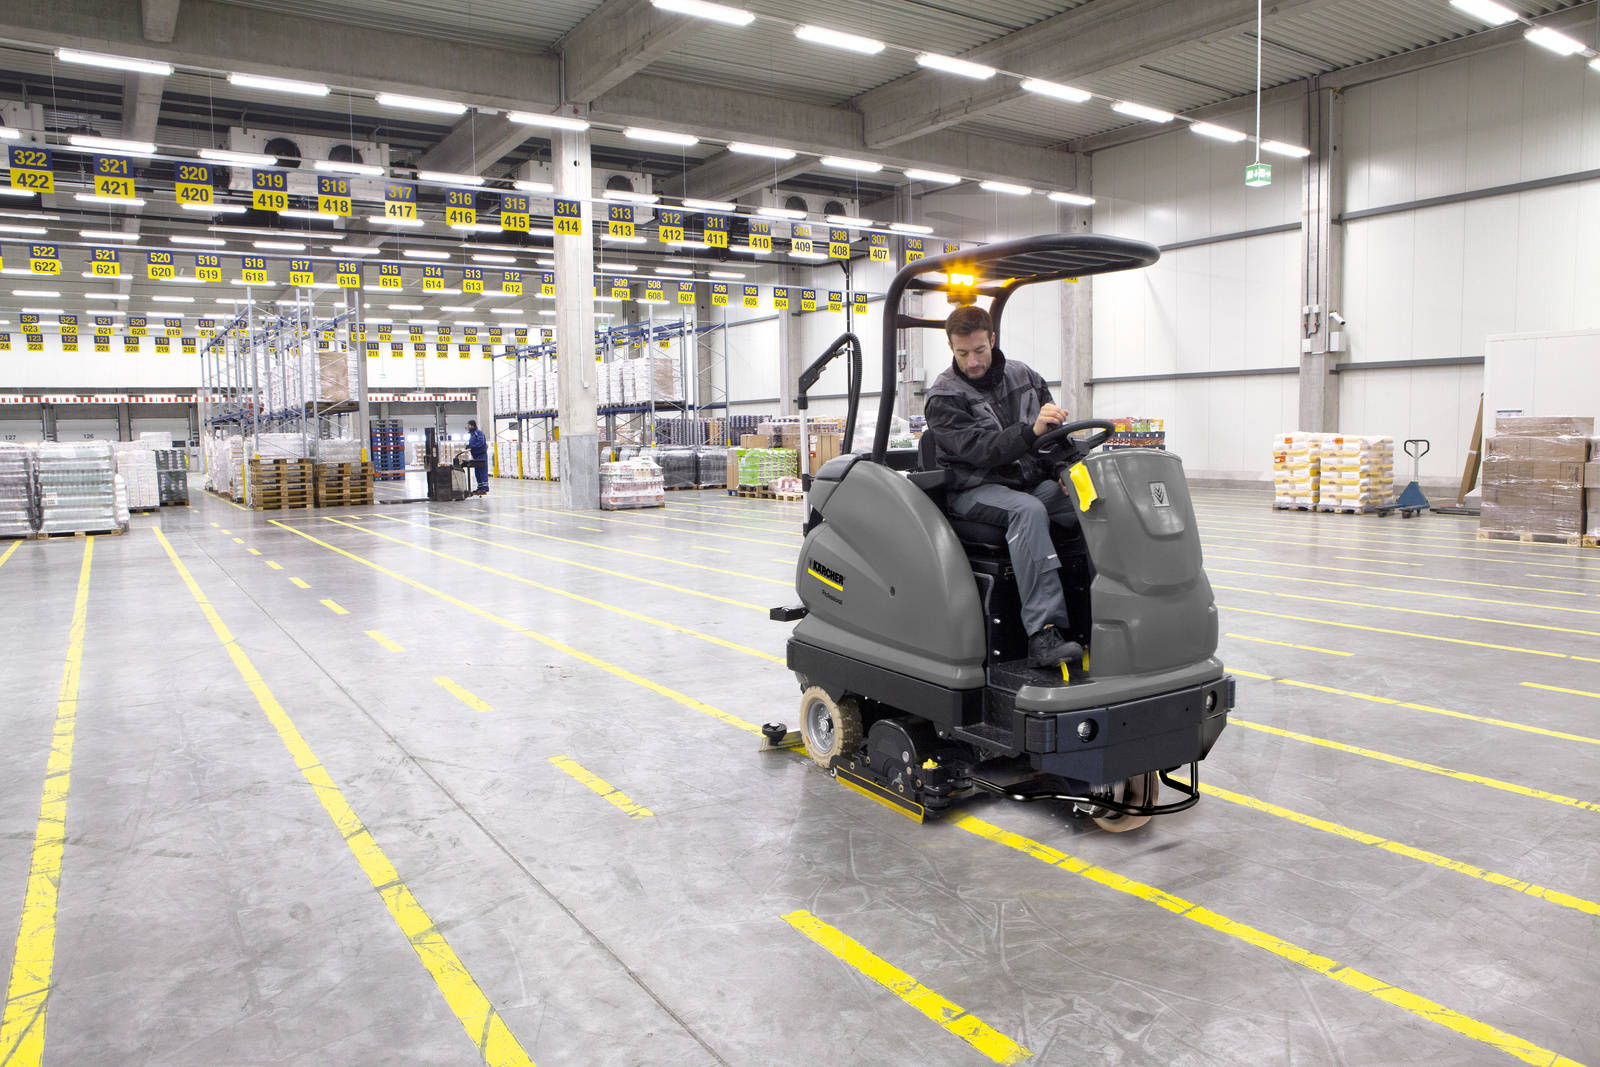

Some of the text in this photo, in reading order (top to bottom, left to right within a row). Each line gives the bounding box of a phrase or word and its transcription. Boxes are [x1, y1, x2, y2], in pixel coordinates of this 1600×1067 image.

[14, 150, 47, 167] 322
[100, 158, 128, 174] 321
[179, 166, 208, 181] 320
[17, 172, 50, 189] 422
[256, 173, 284, 188] 319
[100, 181, 129, 196] 421
[321, 179, 347, 193] 318
[181, 187, 209, 202] 420
[388, 186, 412, 199] 317
[257, 194, 285, 208] 419
[450, 192, 472, 205] 316
[504, 197, 526, 210] 315
[323, 199, 349, 213] 418
[557, 202, 578, 215] 314
[389, 205, 412, 218] 417
[450, 210, 472, 223] 416
[611, 207, 631, 219] 313
[504, 216, 526, 228] 415
[661, 212, 681, 224] 312
[707, 217, 724, 229] 311
[557, 220, 579, 232] 414
[612, 224, 632, 236] 413
[751, 222, 769, 233] 310
[662, 228, 681, 240] 412
[793, 226, 810, 237] 309
[831, 230, 847, 240] 308
[707, 233, 724, 245] 411
[752, 238, 769, 249] 410
[871, 235, 886, 245] 307
[907, 239, 922, 249] 306
[33, 246, 56, 257] 522
[794, 241, 811, 252] 409
[831, 245, 848, 256] 408
[95, 250, 116, 260] 521
[150, 253, 171, 263] 520
[872, 249, 887, 259] 407
[198, 256, 218, 266] 519
[245, 258, 264, 268] 518
[292, 260, 309, 270] 517
[34, 261, 57, 272] 622
[96, 264, 116, 275] 621
[339, 263, 356, 273] 516
[381, 265, 398, 274] 515
[425, 267, 442, 276] 514
[151, 267, 172, 277] 620
[199, 270, 218, 280] 619
[245, 272, 264, 282] 618
[465, 269, 482, 278] 513
[504, 271, 520, 280] 512
[293, 274, 310, 284] 617
[339, 276, 357, 286] 616
[544, 273, 554, 282] 51
[382, 278, 399, 288] 615
[425, 280, 442, 289] 614
[465, 282, 481, 291] 613
[614, 279, 628, 287] 509
[647, 280, 661, 289] 508
[679, 282, 693, 291] 507
[505, 284, 520, 293] 612
[544, 286, 554, 295] 61
[714, 284, 727, 293] 506
[745, 286, 757, 295] 505
[775, 288, 787, 297] 504
[614, 290, 628, 299] 609
[647, 291, 662, 300] 608
[680, 293, 693, 301] 607
[714, 295, 727, 303] 606
[803, 290, 814, 299] 503
[830, 292, 841, 300] 502
[856, 294, 866, 302] 501
[745, 297, 757, 306] 605
[775, 299, 787, 308] 604
[803, 301, 815, 309] 603
[830, 303, 841, 311] 602
[856, 304, 866, 312] 601
[22, 315, 38, 323] 523
[60, 316, 76, 324] 522
[97, 317, 111, 325] 521
